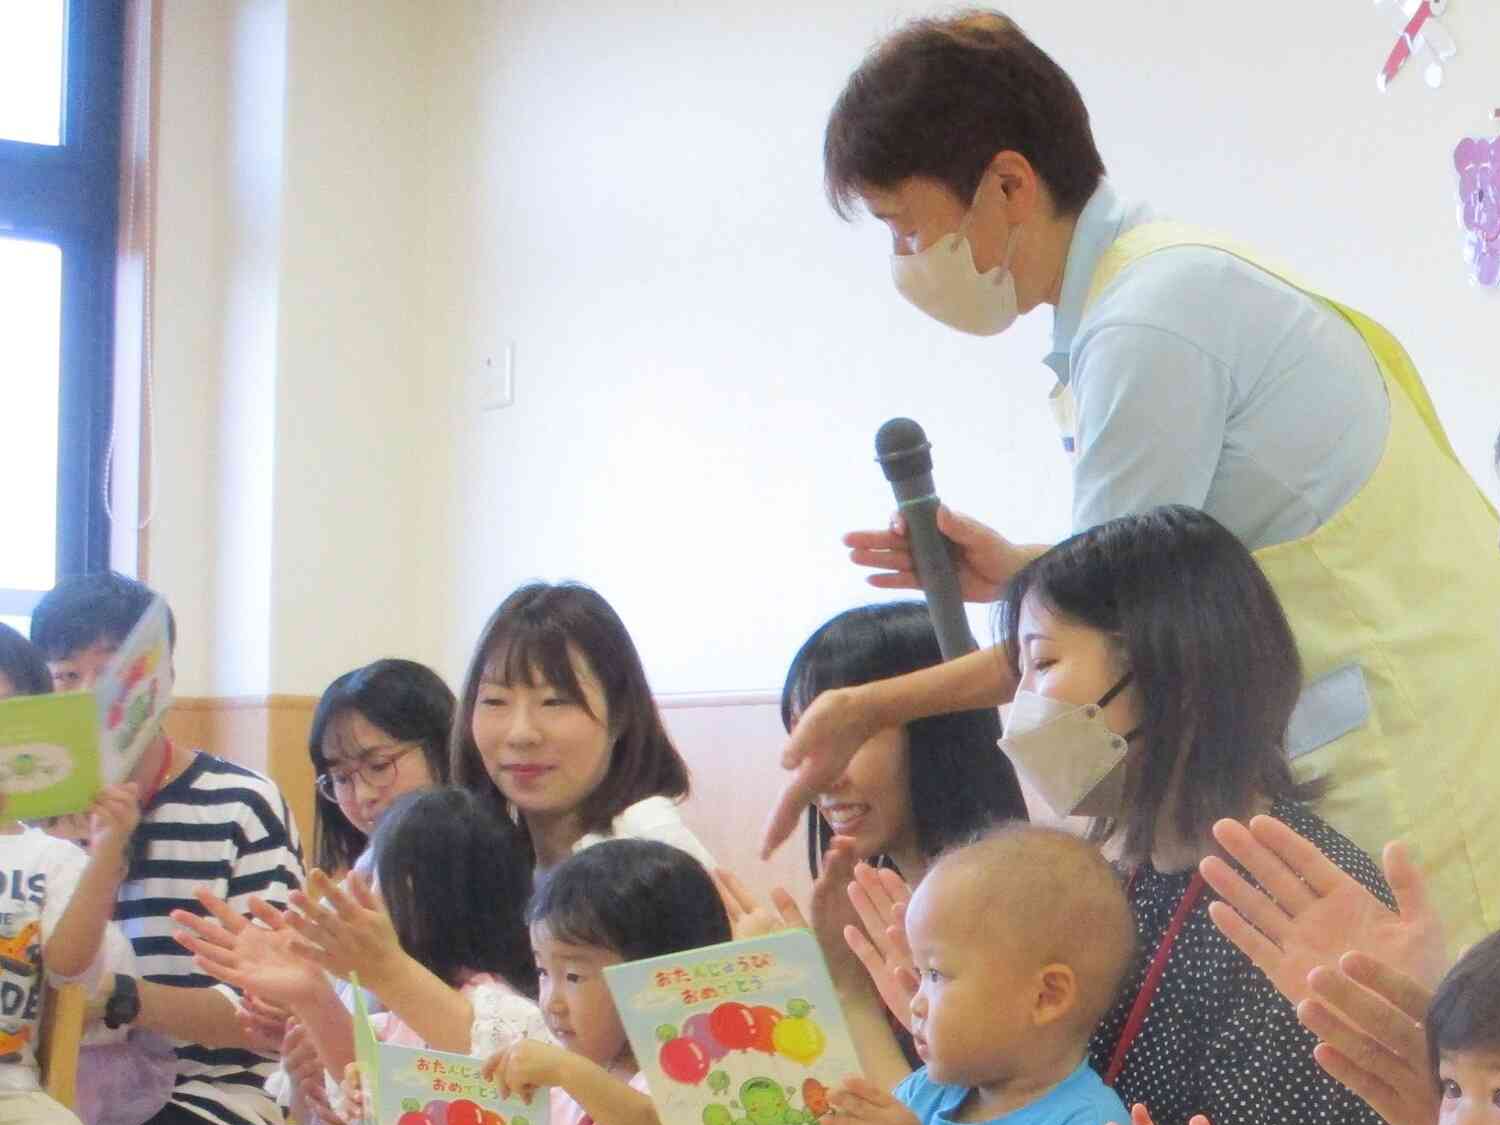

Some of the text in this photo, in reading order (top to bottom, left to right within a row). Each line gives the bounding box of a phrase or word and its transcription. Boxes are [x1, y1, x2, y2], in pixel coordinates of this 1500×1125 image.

[416, 1056, 481, 1080] おたんじょ
